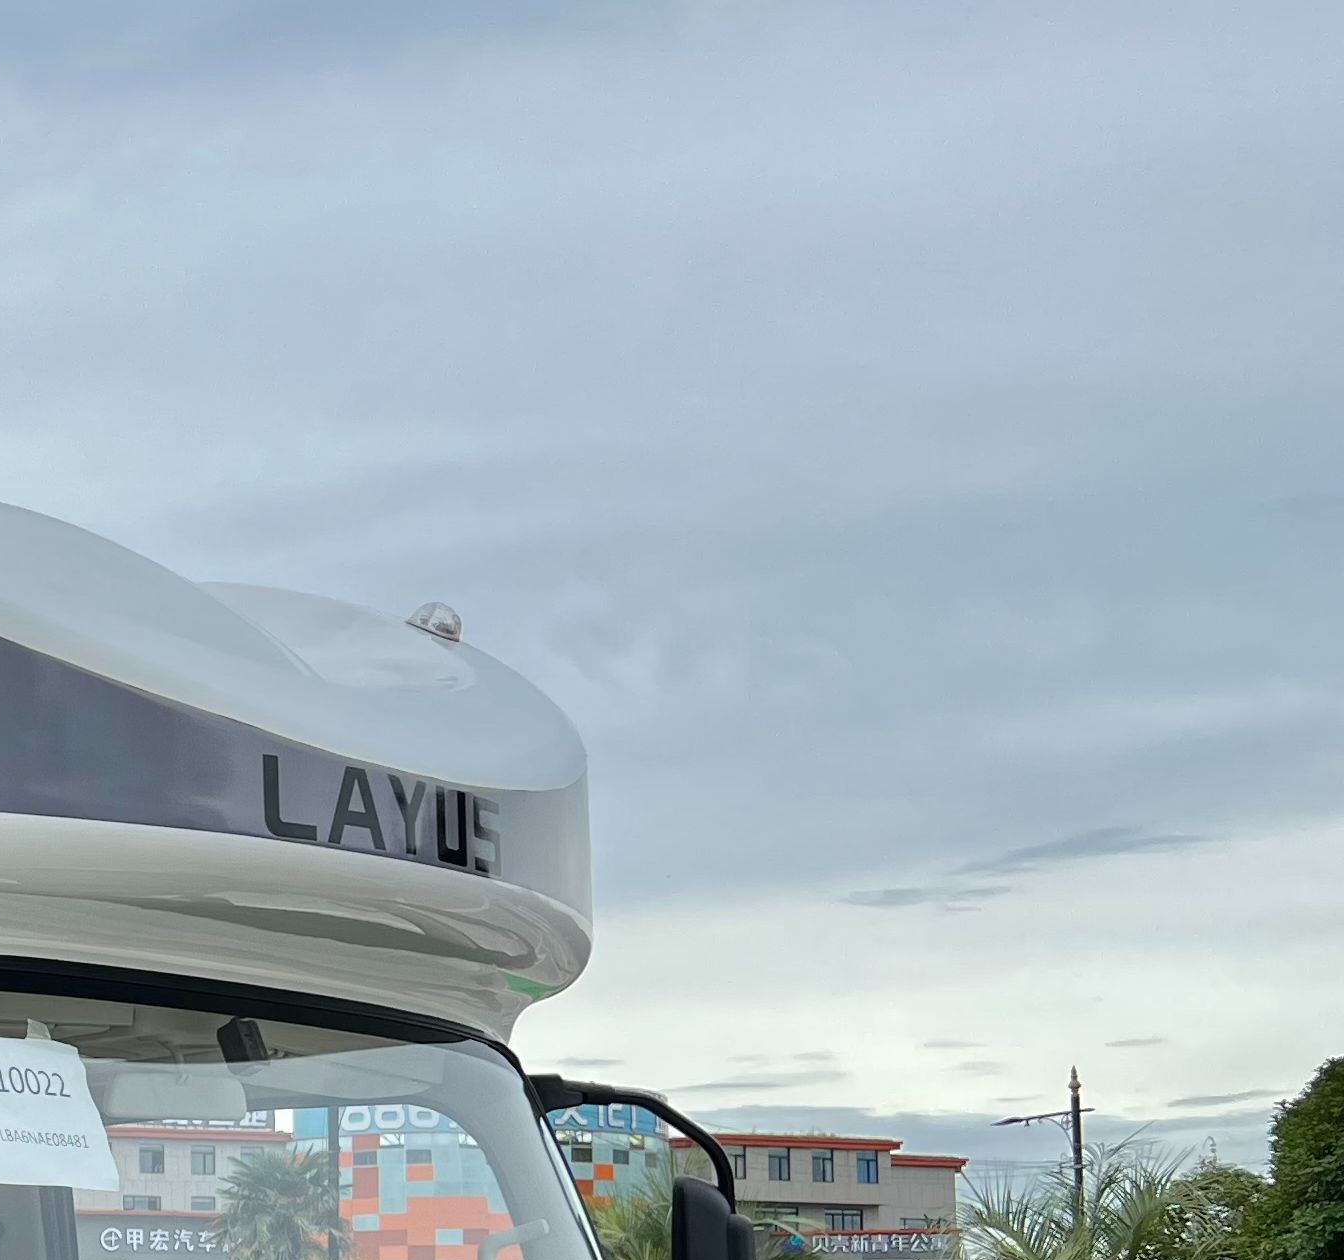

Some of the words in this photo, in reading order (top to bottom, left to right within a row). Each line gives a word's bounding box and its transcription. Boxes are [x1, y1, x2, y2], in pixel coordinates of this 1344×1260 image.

[262, 754, 502, 877] LAYUS
[126, 1227, 242, 1254] 甲宏汽车
